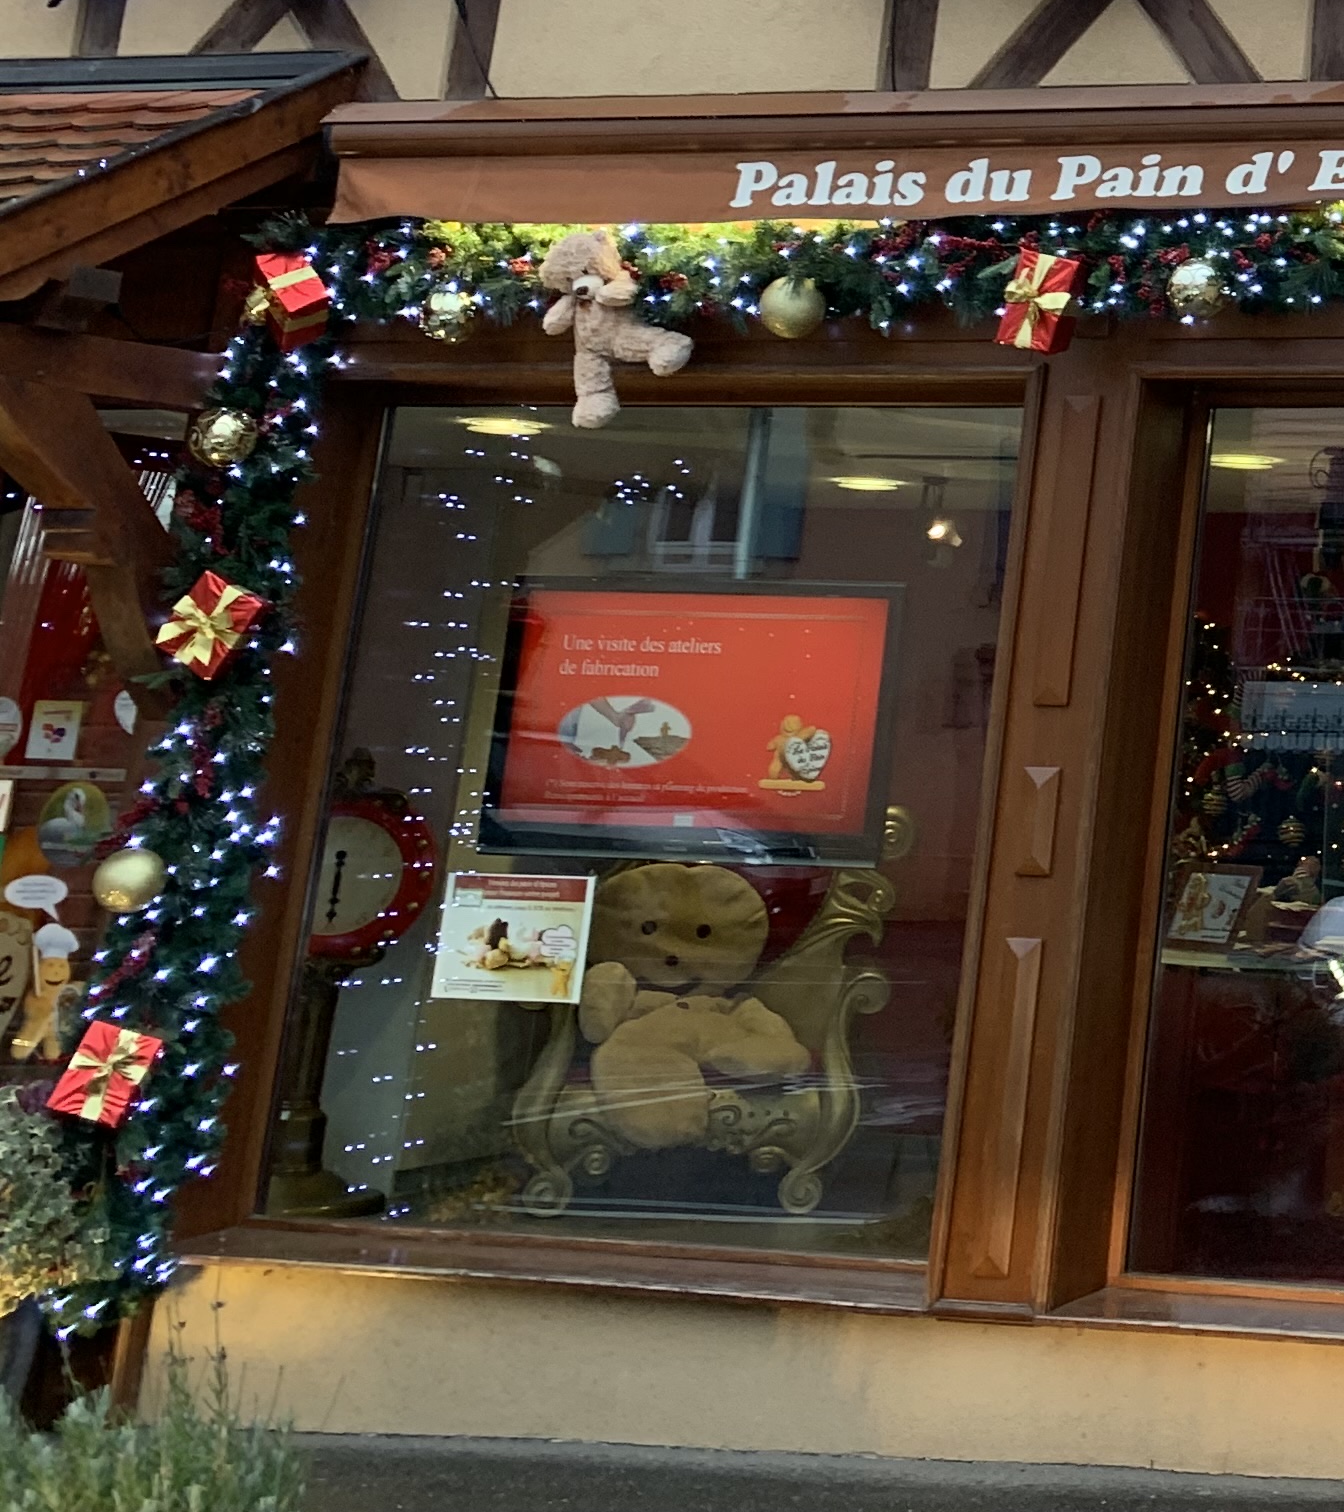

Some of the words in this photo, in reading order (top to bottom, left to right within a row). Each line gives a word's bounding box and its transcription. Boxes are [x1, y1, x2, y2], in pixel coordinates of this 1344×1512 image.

[729, 159, 927, 208] Palais
[944, 157, 1033, 204] du
[1049, 153, 1205, 201] Pain
[562, 633, 593, 652] Une
[597, 634, 637, 652] visite
[639, 636, 666, 653] des
[668, 637, 722, 655] ateliers
[558, 658, 577, 676] de
[580, 659, 660, 678] fabrication
